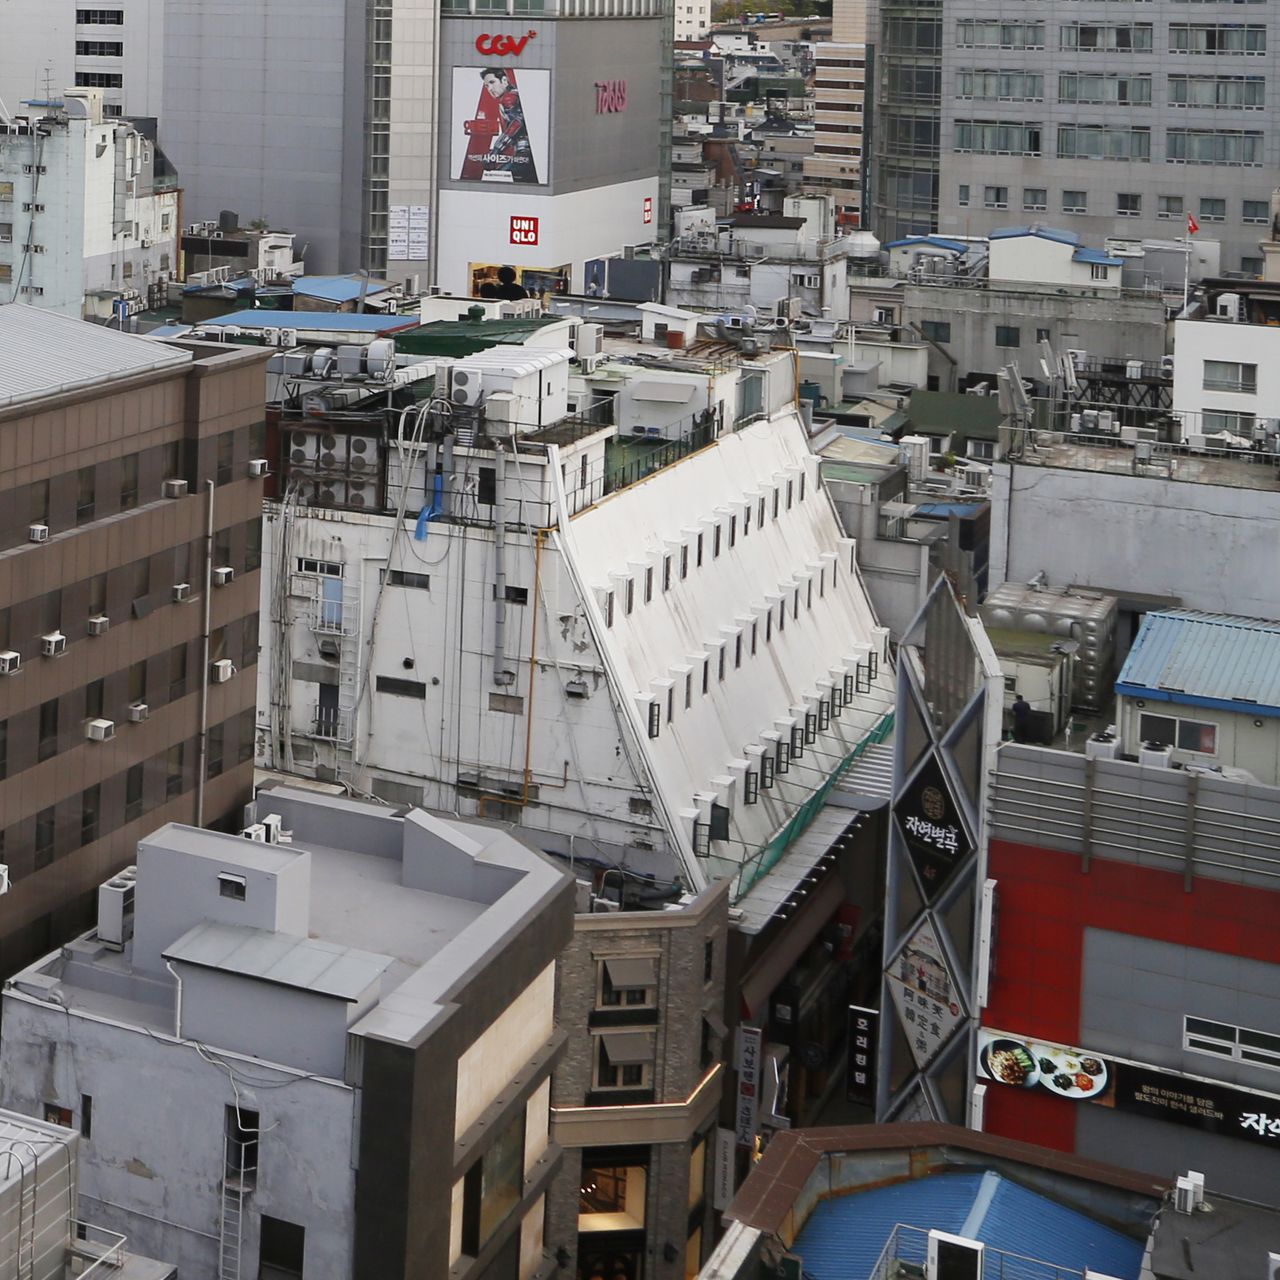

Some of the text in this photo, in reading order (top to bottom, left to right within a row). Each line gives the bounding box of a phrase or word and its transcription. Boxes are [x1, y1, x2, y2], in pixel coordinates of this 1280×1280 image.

[475, 33, 528, 57] CGV
[513, 219, 534, 231] UNI
[512, 231, 536, 242] QLO
[905, 815, 959, 854] 자연별곡
